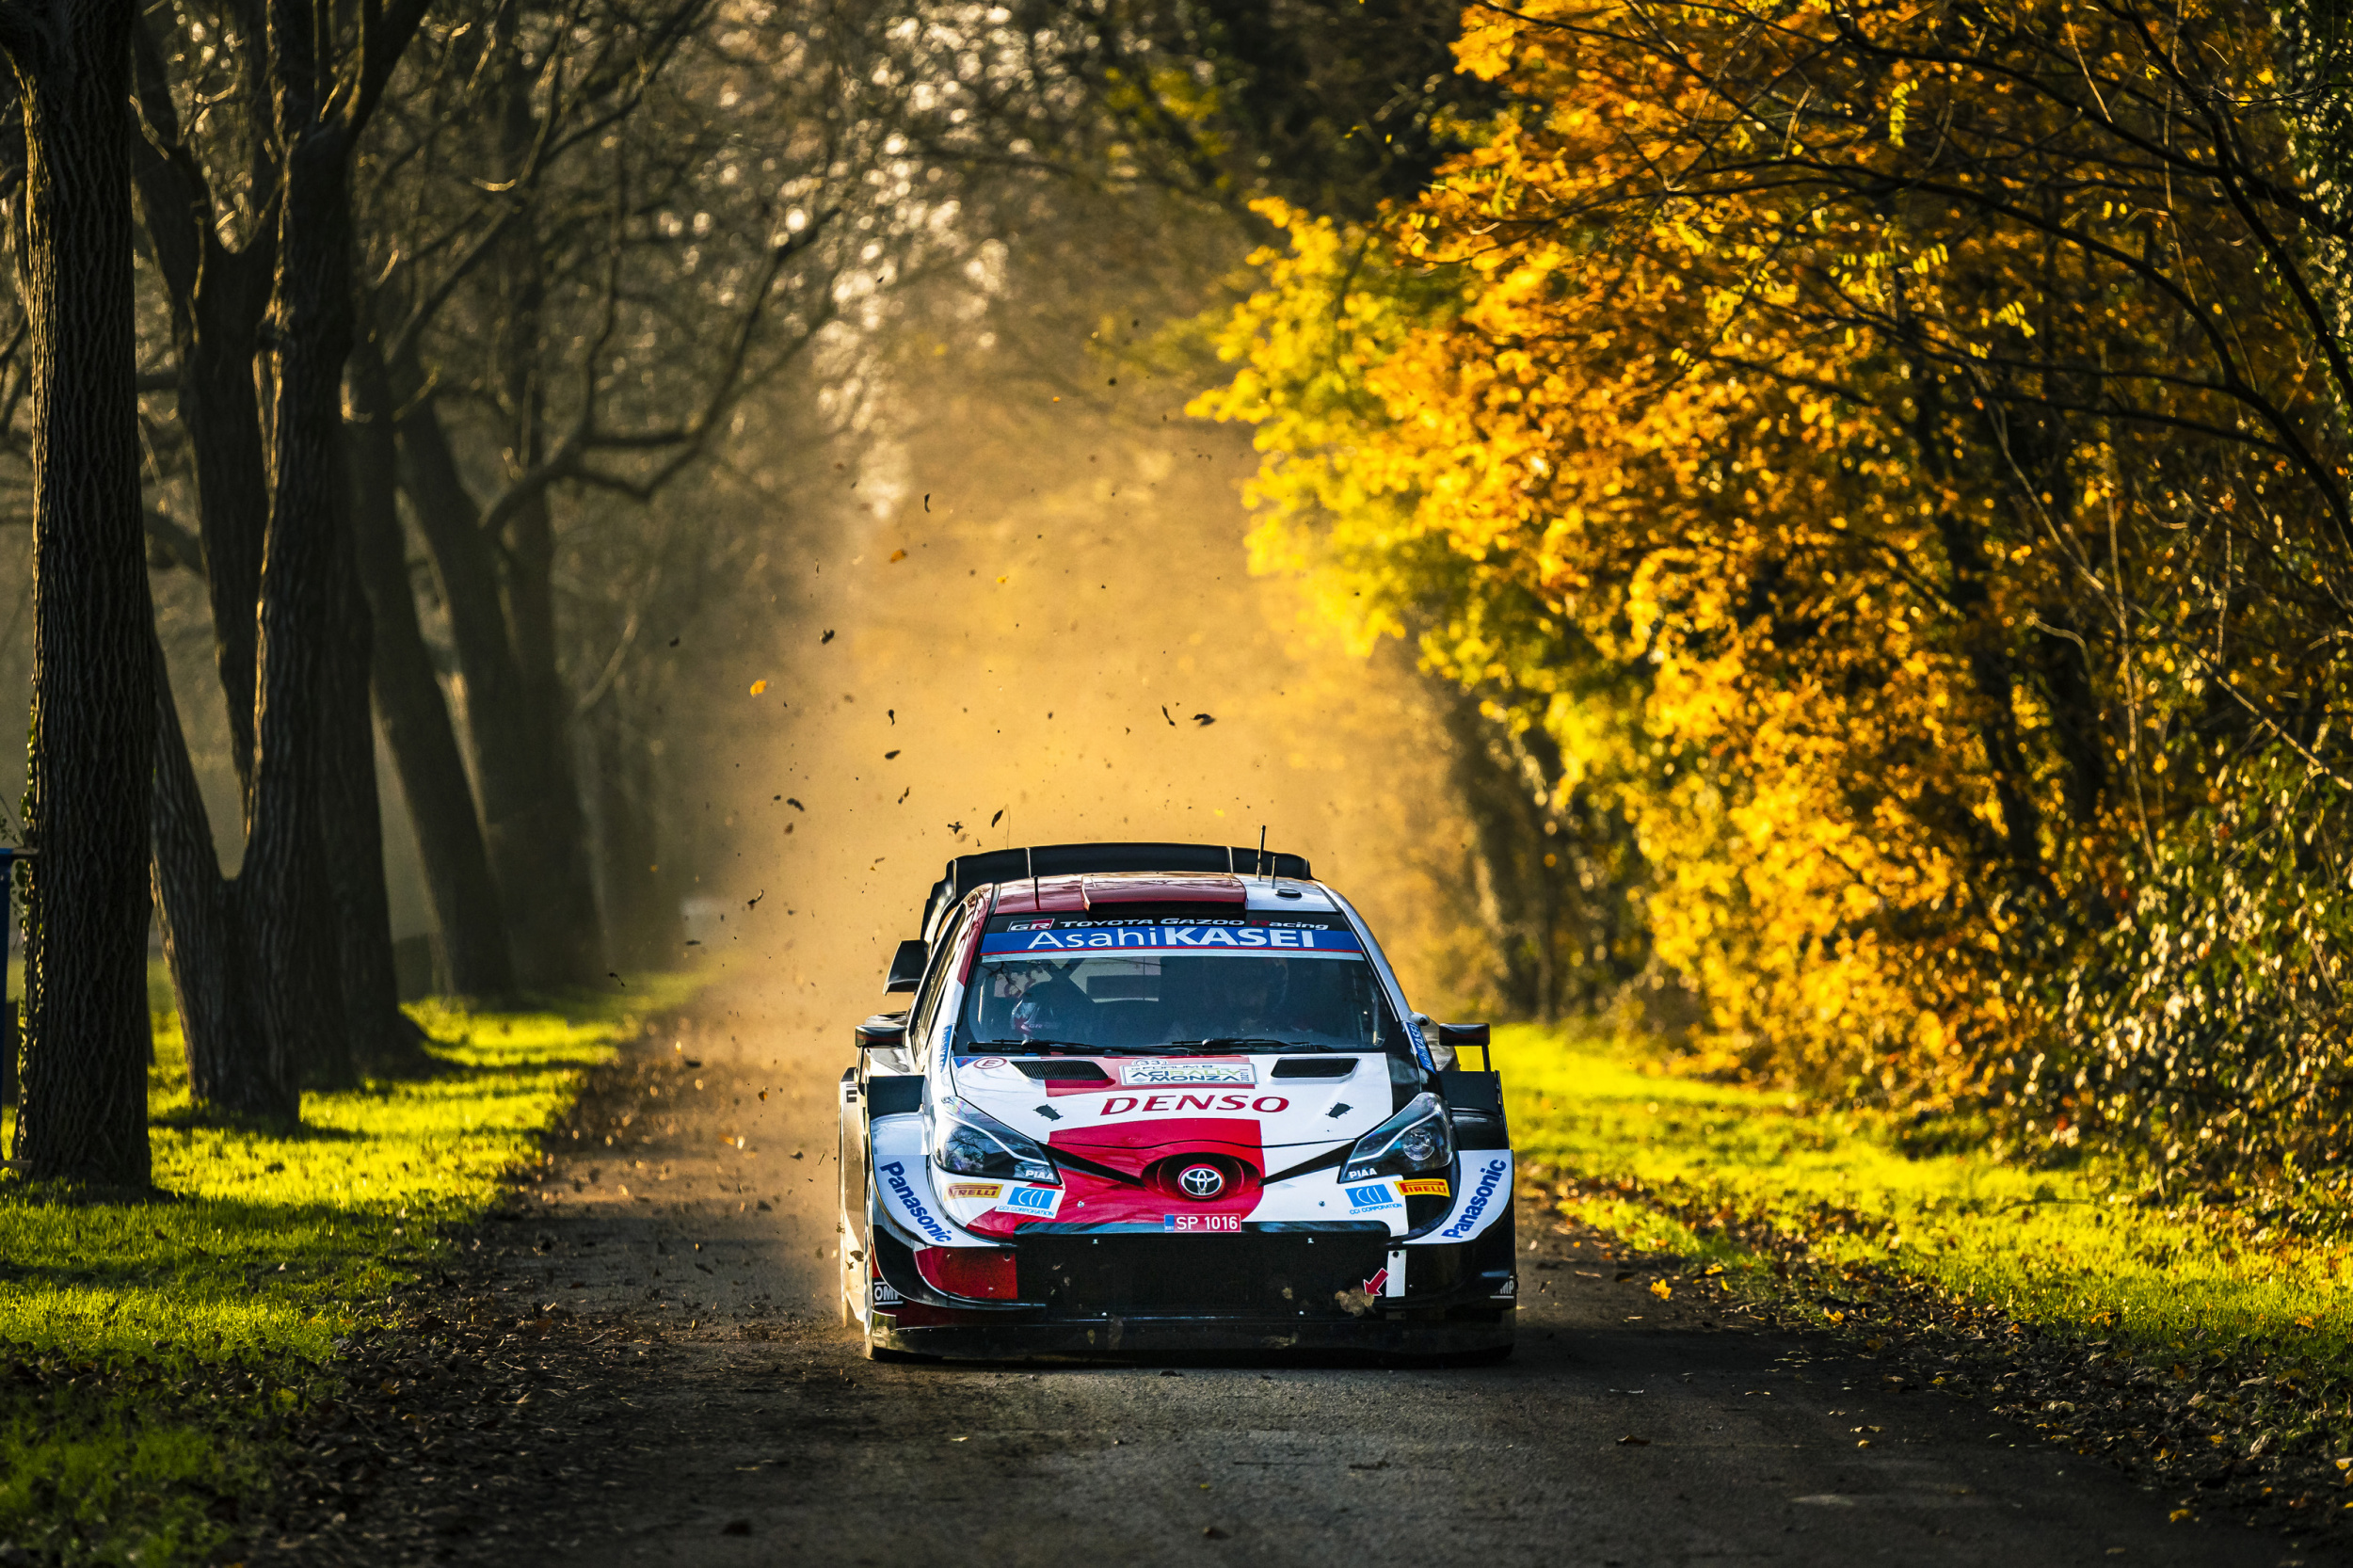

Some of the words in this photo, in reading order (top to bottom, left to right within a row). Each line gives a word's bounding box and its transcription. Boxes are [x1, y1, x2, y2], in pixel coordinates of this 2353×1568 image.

[1010, 922, 1050, 931] GR
[1060, 919, 1154, 928] TOYOTA
[1251, 920, 1329, 931] Racing
[1099, 1095, 1289, 1116] DENSO
[1025, 1169, 1054, 1180] PIAA
[1349, 1168, 1378, 1179] PIAA
[949, 1185, 999, 1197] PIRELLI
[1399, 1181, 1447, 1193] PIRELLI
[879, 1160, 952, 1242] Panasonic
[1441, 1160, 1507, 1239] Panasonic
[1011, 1206, 1055, 1217] CORPORATION
[1361, 1203, 1402, 1213] CORPORATION
[1176, 1216, 1198, 1230] SP
[1205, 1216, 1238, 1230] 1016
